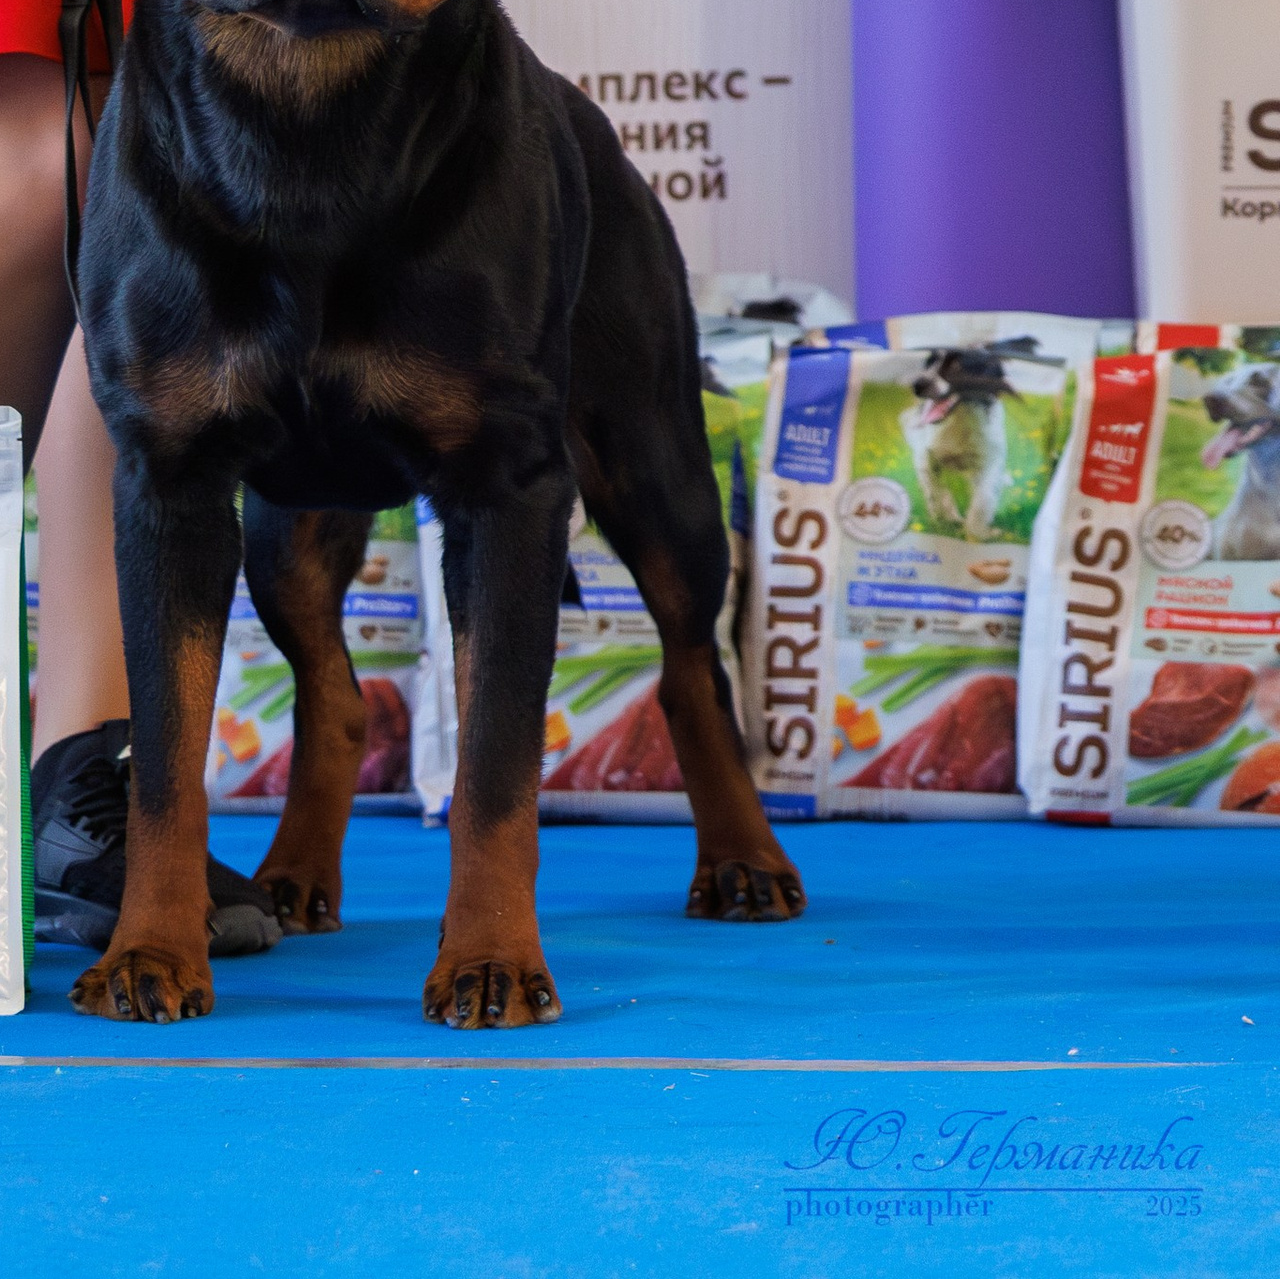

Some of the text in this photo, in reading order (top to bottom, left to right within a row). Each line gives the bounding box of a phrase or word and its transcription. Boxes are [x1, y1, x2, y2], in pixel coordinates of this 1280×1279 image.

[1221, 198, 1280, 222] Кор
[766, 506, 829, 762] SIRIUS
[1053, 523, 1131, 781] SIRIUS
